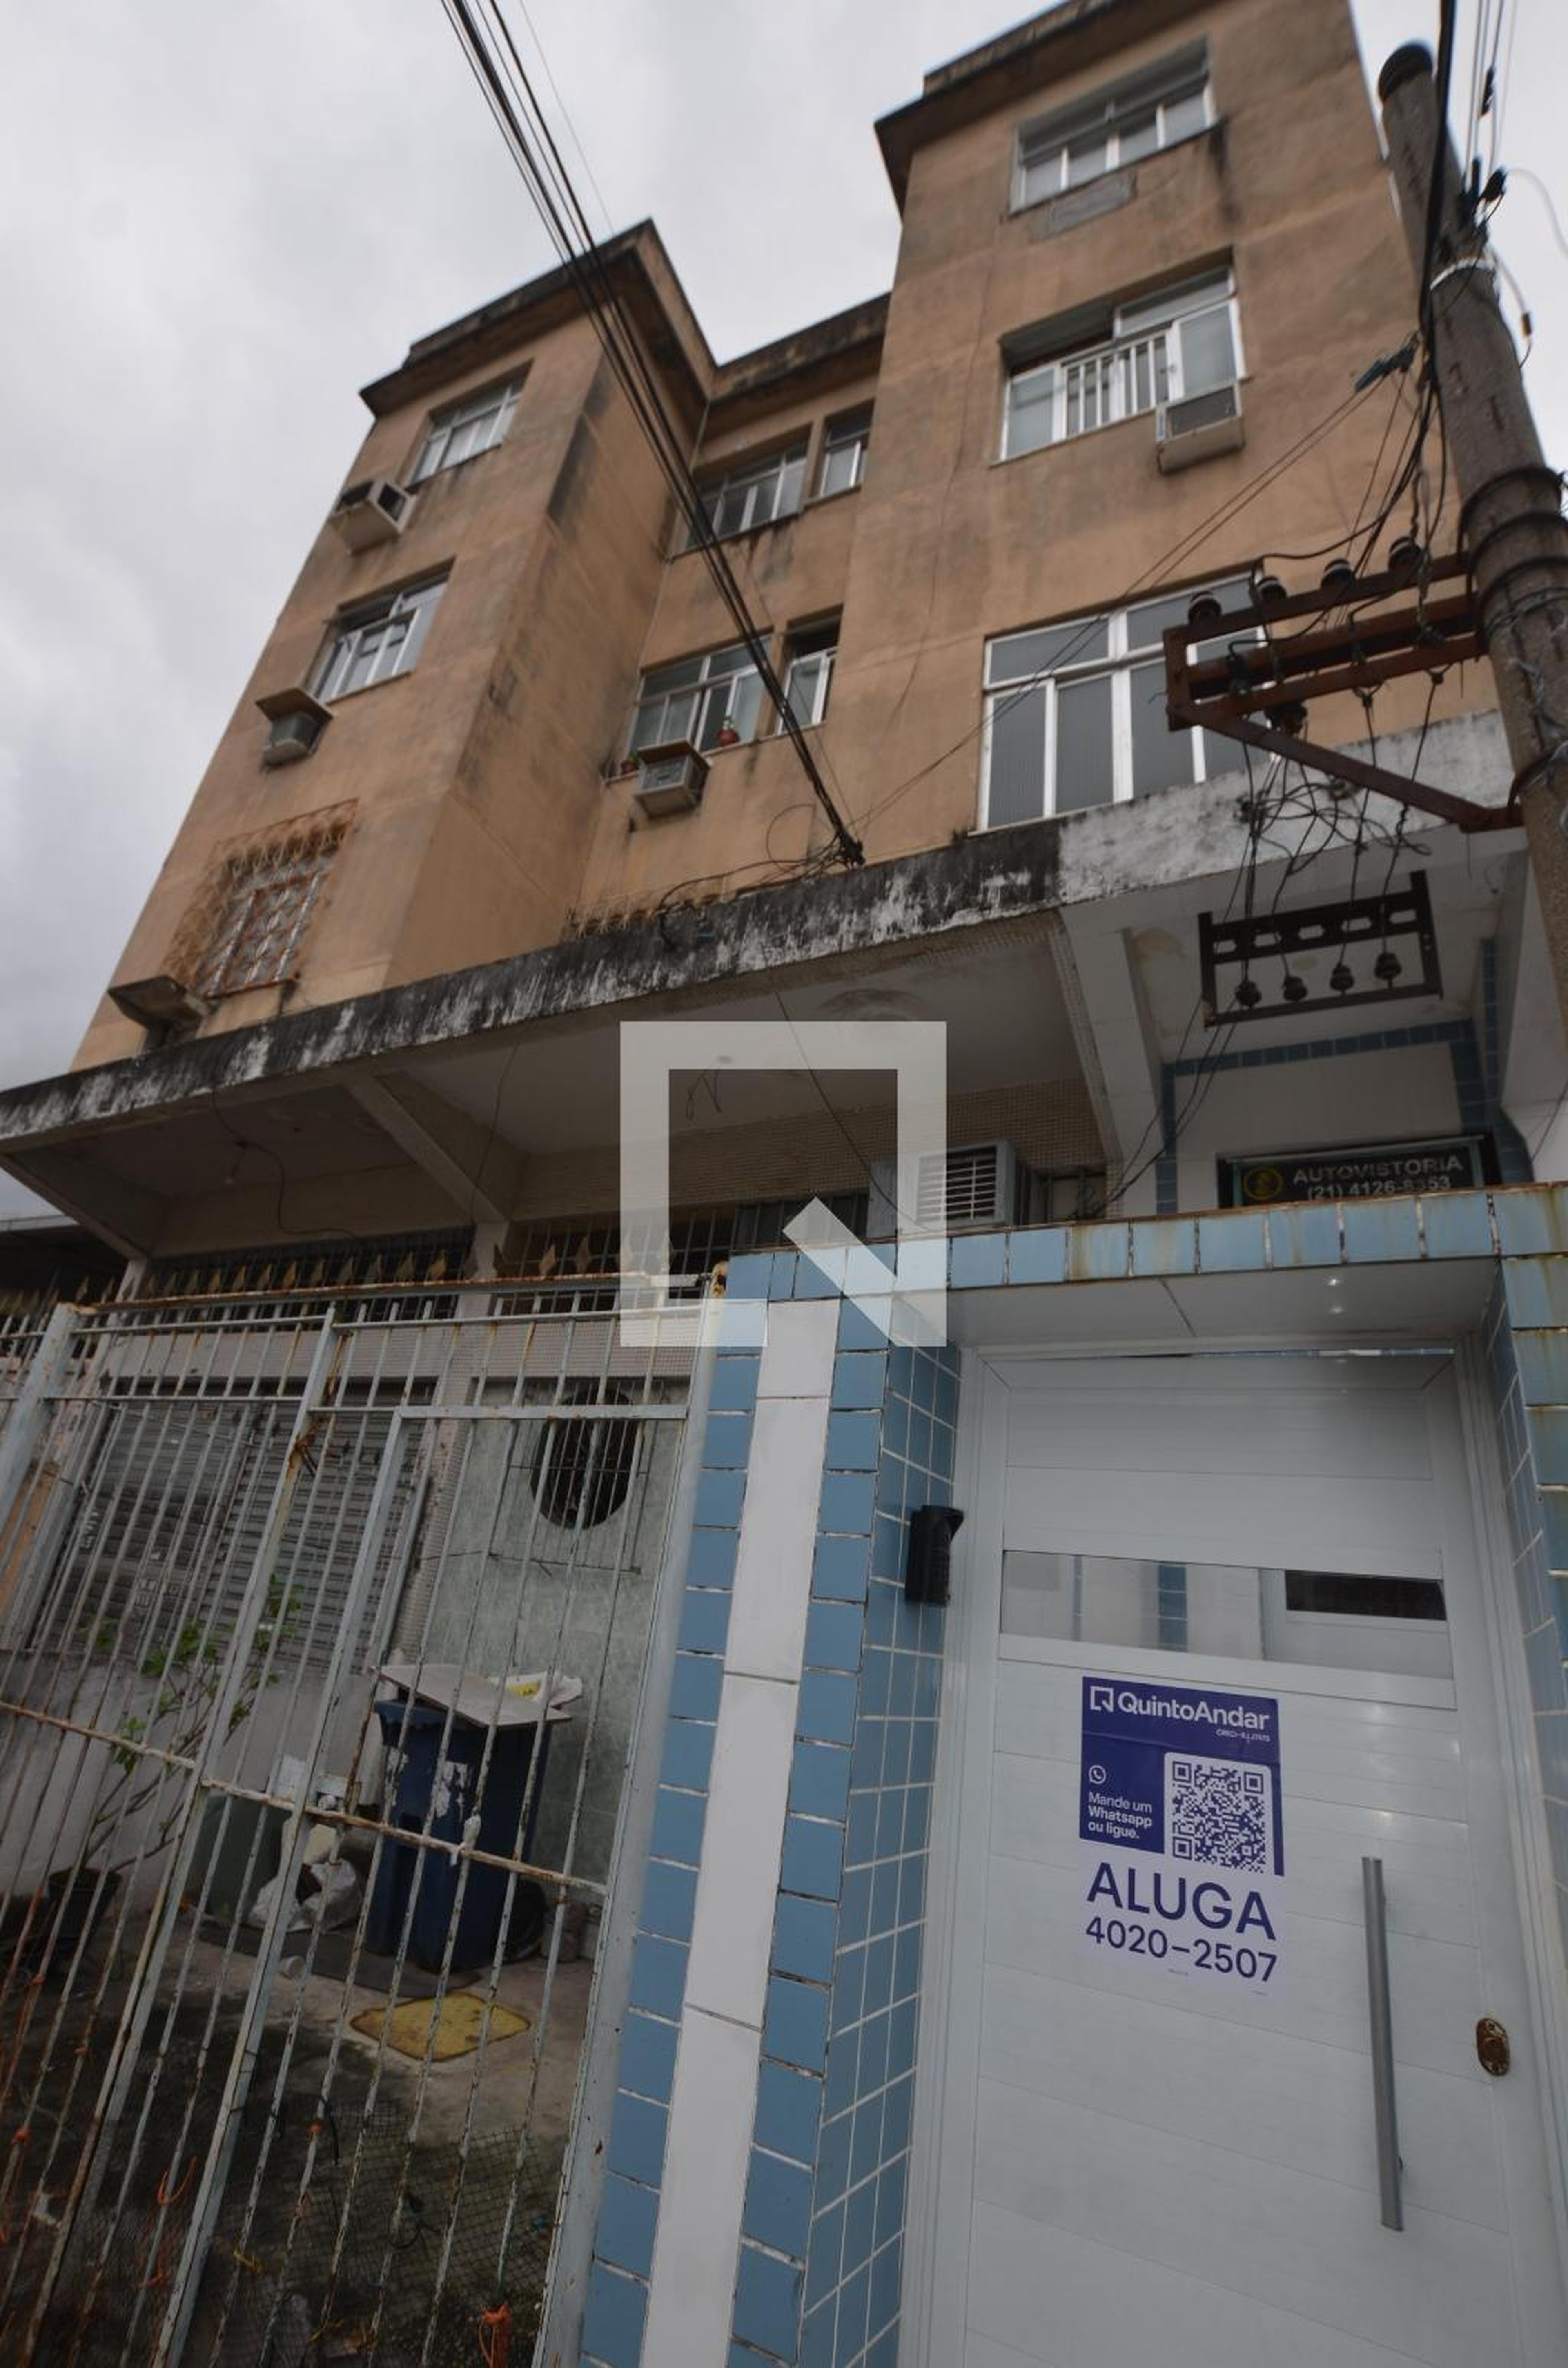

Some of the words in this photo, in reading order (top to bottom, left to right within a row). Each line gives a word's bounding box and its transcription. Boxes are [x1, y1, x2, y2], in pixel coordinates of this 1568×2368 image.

[1293, 1155, 1463, 1185] AUTOVISTORIA
[1308, 1184, 1343, 1201] (21)
[1118, 1692, 1270, 1730] QuintoAndar
[1089, 1791, 1130, 1810] Mande
[1133, 1801, 1152, 1813] um
[1088, 1804, 1152, 1829] Whatsapp
[1088, 1822, 1103, 1832] ou
[1107, 1821, 1140, 1839] ligue.
[1087, 1862, 1277, 1941] ALUGA
[1086, 1916, 1277, 1982] 4020-2507
